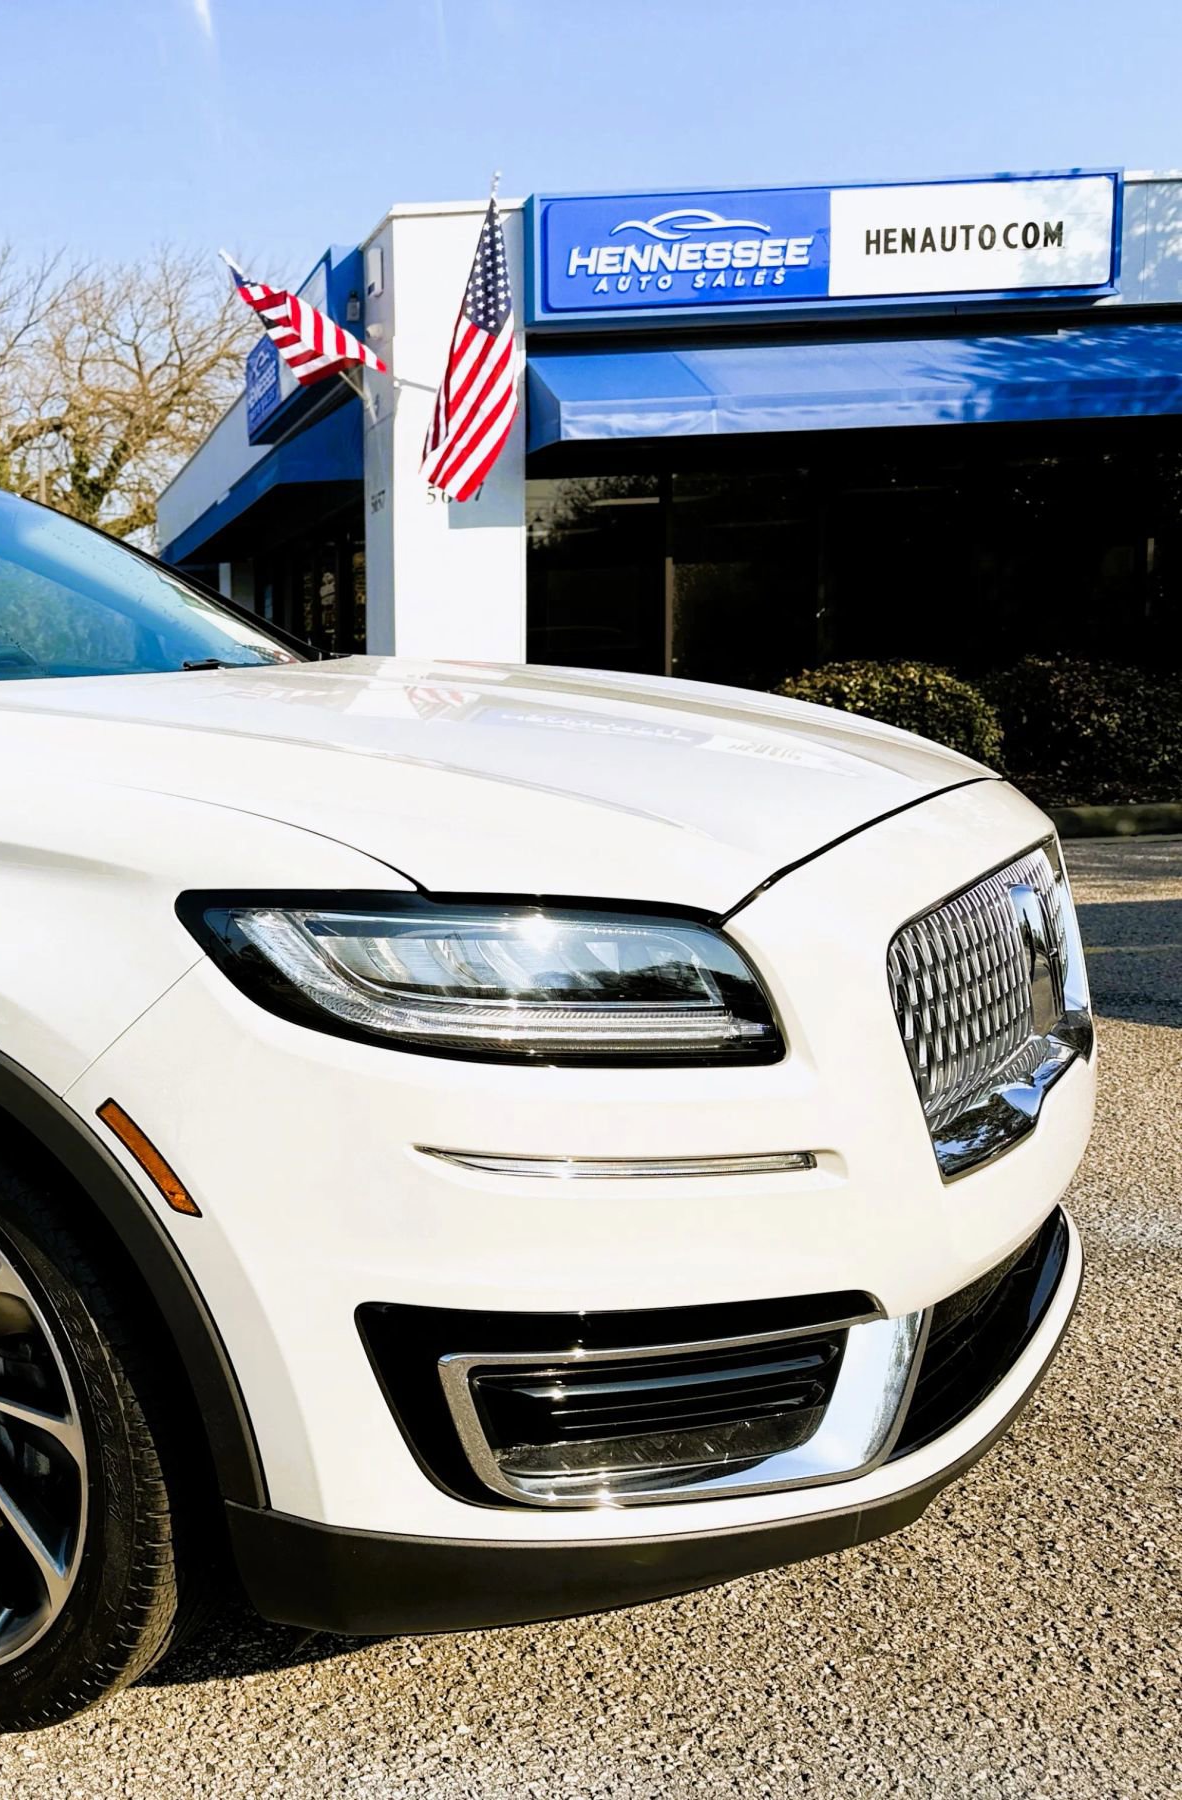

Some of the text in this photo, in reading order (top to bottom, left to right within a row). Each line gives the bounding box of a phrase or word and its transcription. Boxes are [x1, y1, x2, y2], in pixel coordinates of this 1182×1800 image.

[568, 236, 814, 276] HENNESSEE
[593, 267, 786, 293] AUTO SALES
